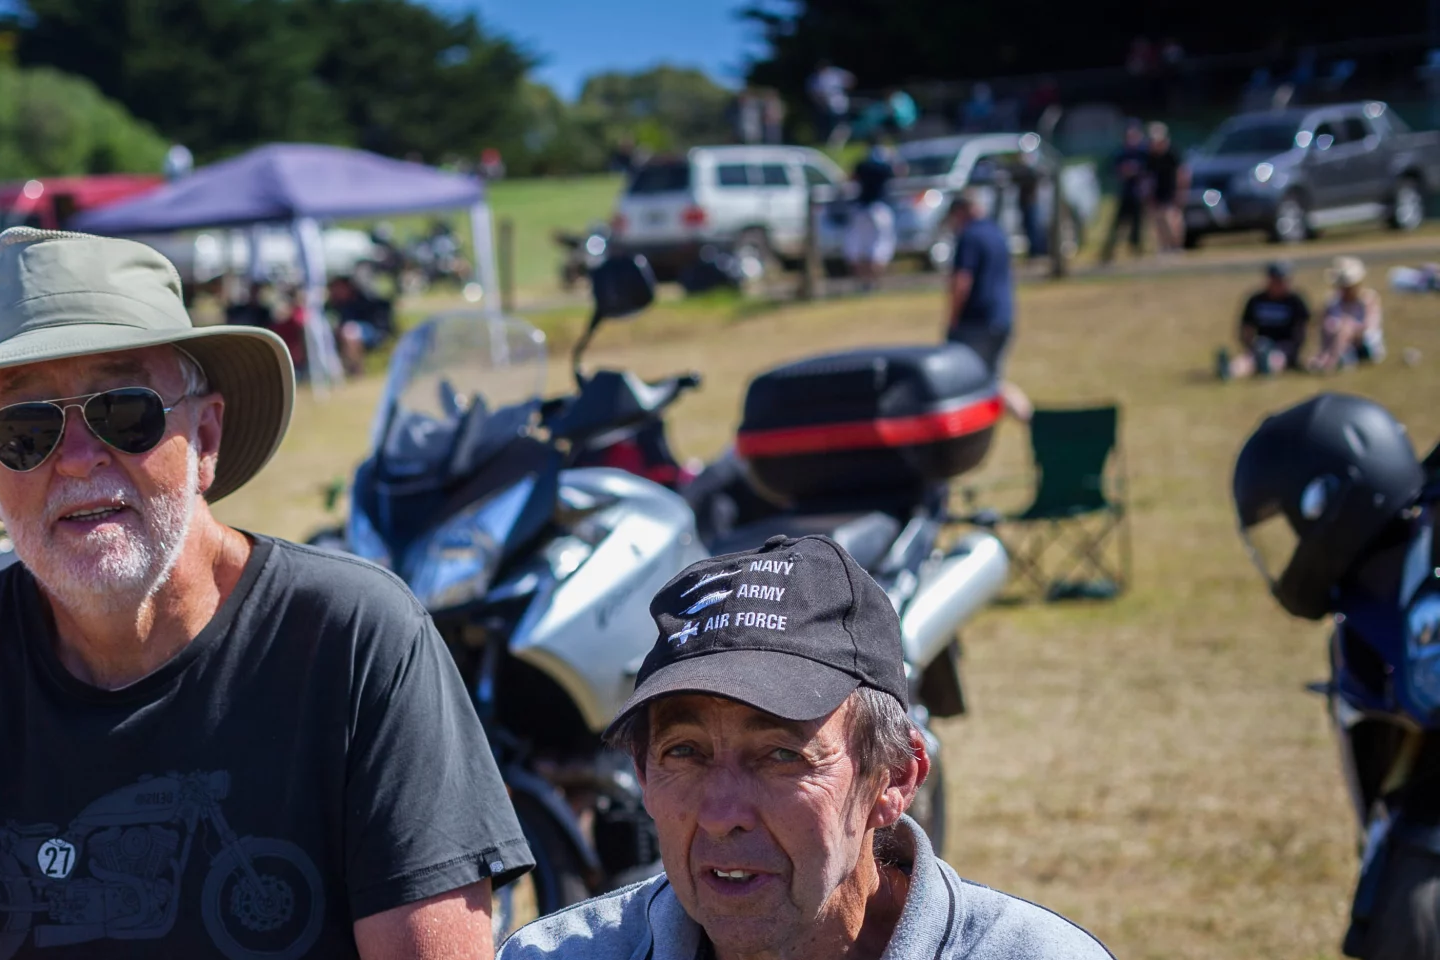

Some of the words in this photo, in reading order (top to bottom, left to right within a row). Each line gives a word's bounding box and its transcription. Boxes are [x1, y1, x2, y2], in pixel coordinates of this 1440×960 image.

[749, 560, 794, 576] NAVY
[736, 583, 786, 602] ARMY
[704, 612, 730, 633] AIR
[734, 611, 788, 632] FORCE
[44, 846, 71, 875] 27
